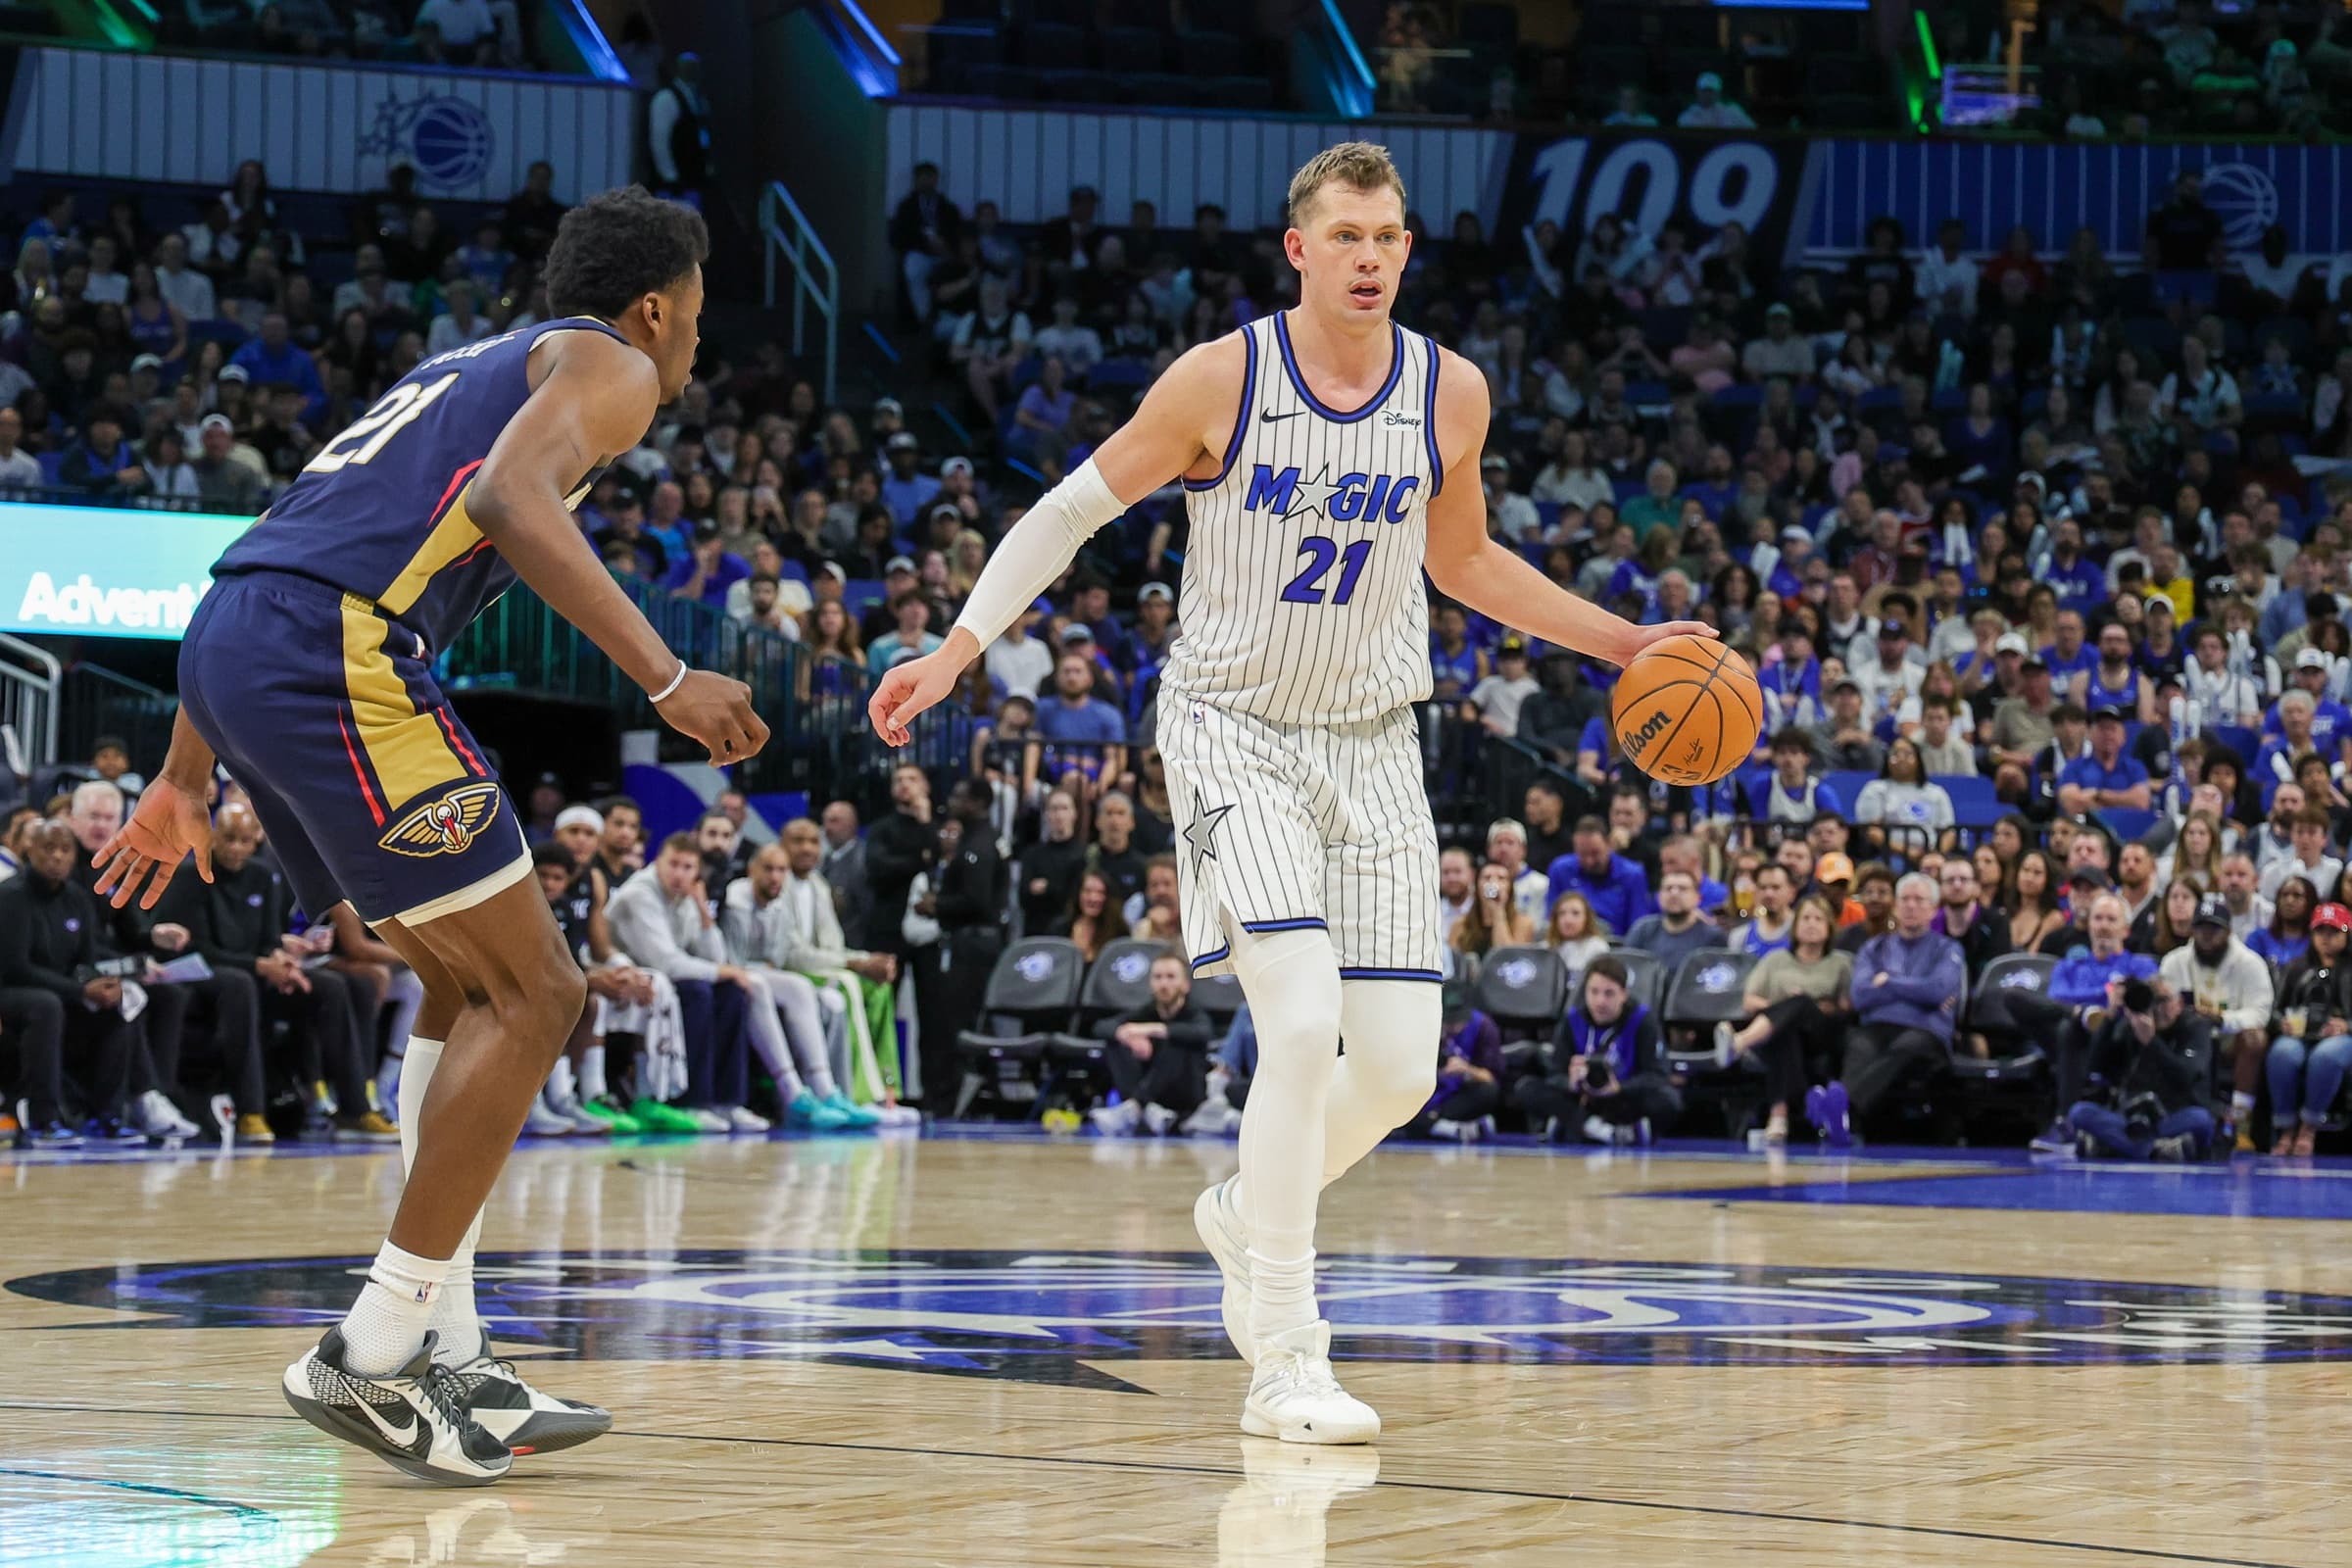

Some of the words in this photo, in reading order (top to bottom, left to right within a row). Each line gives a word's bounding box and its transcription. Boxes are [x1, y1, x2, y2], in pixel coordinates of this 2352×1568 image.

[1532, 136, 1779, 235] 109
[302, 372, 461, 472] 21
[18, 571, 215, 628] Advent
[1279, 536, 1374, 605] 21
